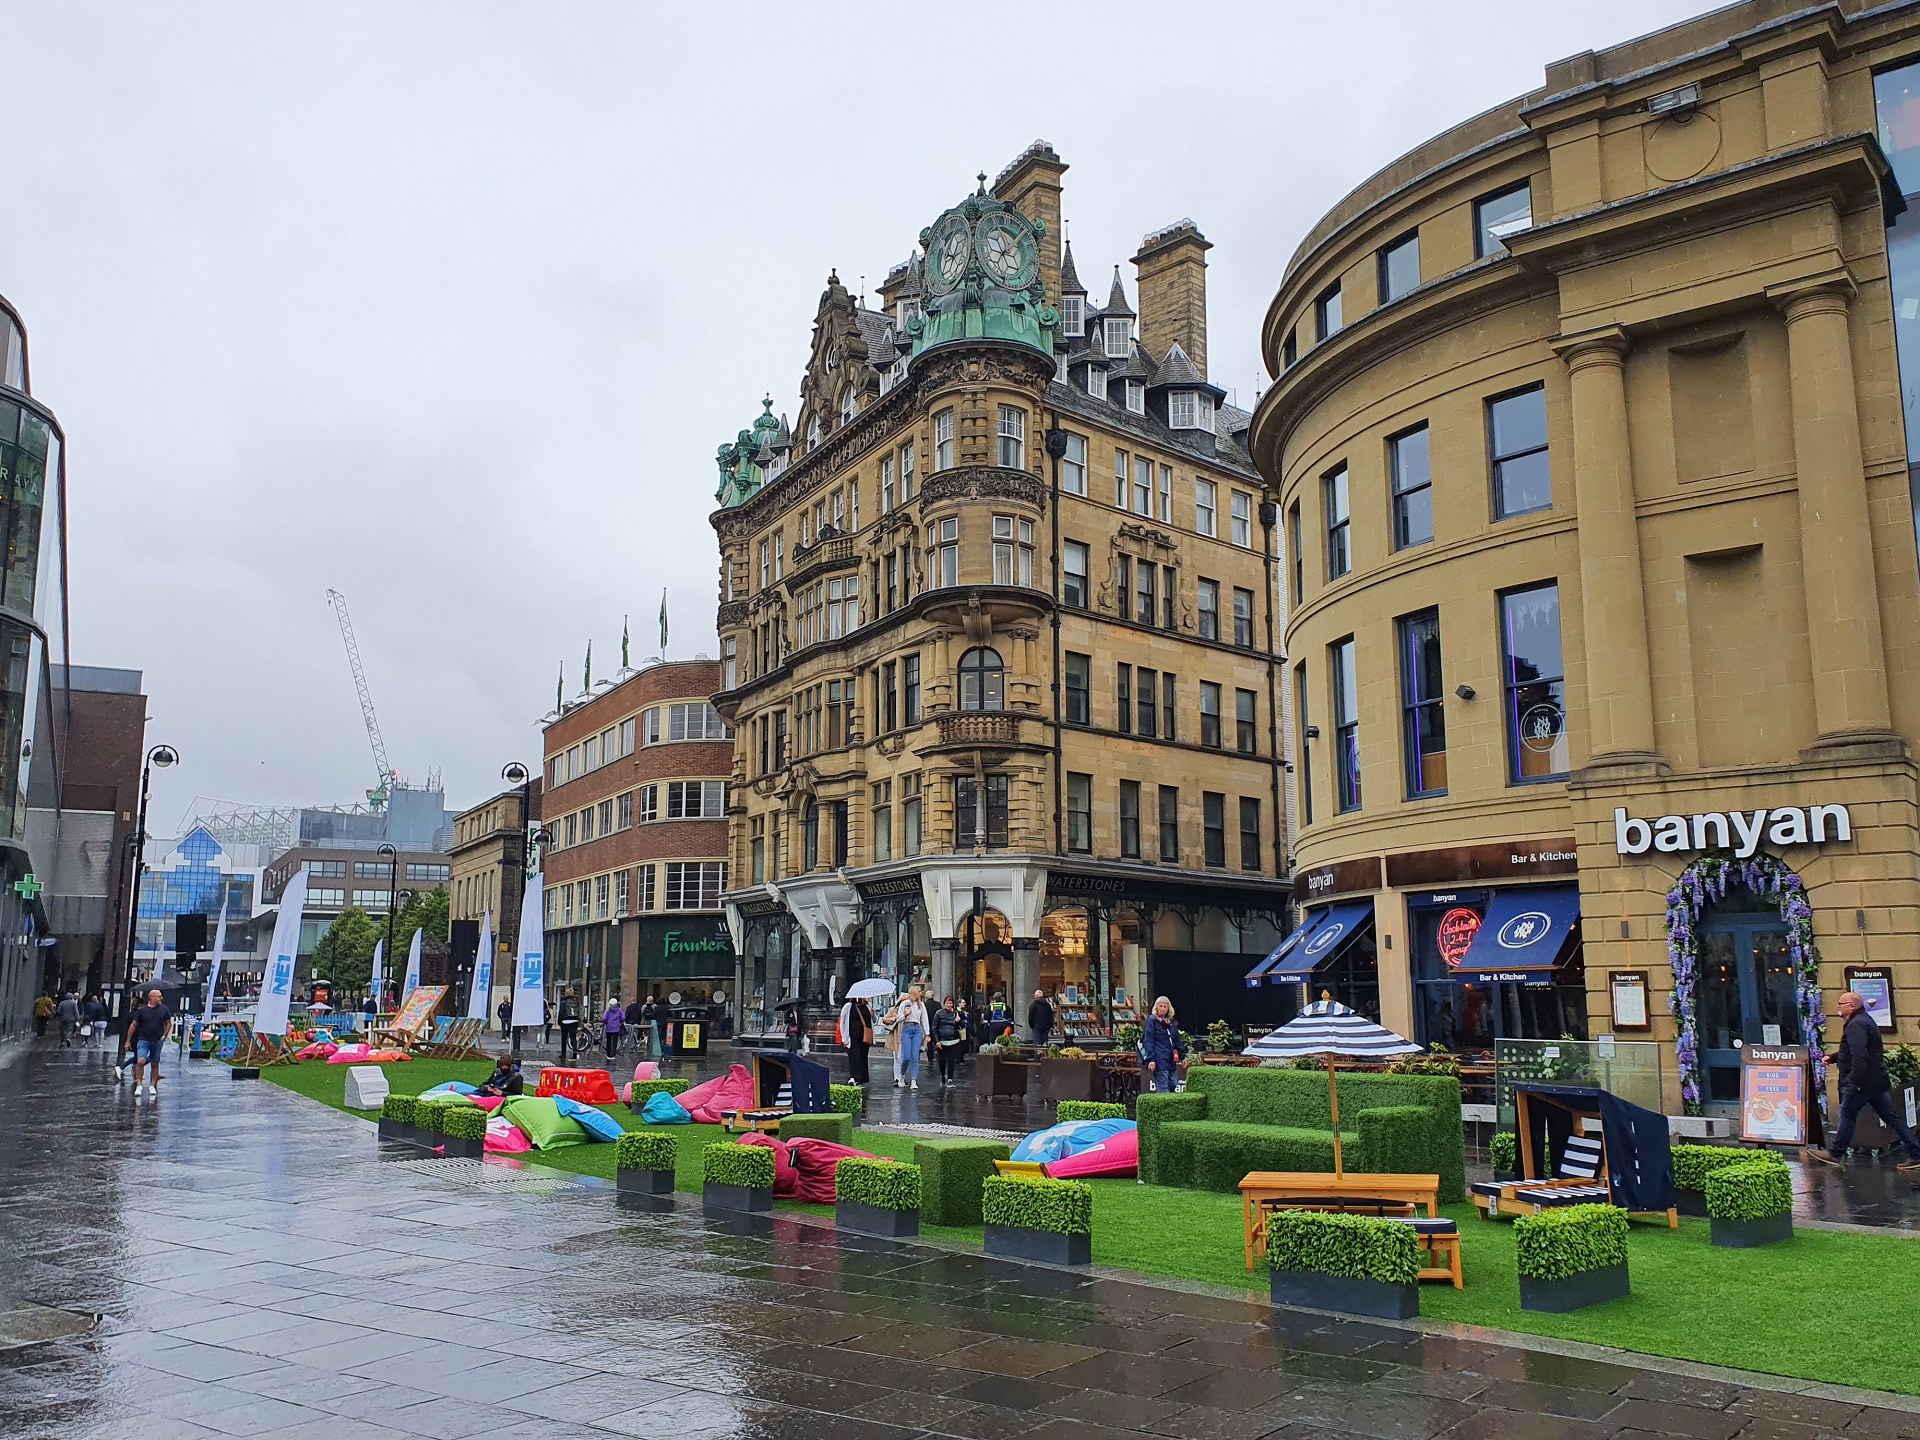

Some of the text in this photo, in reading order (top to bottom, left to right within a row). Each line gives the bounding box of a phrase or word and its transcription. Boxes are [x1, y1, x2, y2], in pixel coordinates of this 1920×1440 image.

[780, 420, 887, 506] EMERSON CHAMBERS
[1614, 804, 1851, 858] banyan
[1511, 851, 1577, 864] Bar & Kitchen
[865, 878, 920, 895] WATERSTONES
[1047, 875, 1126, 892] WATERSTONES
[1308, 873, 1334, 891] banyan
[1433, 894, 1457, 903] banyan
[663, 931, 729, 957] Fenwick
[272, 955, 291, 995] NE1
[479, 963, 490, 990] NE1
[523, 953, 542, 989] NE1
[1500, 973, 1527, 981] Kitchen
[1752, 1049, 1796, 1060] banyan
